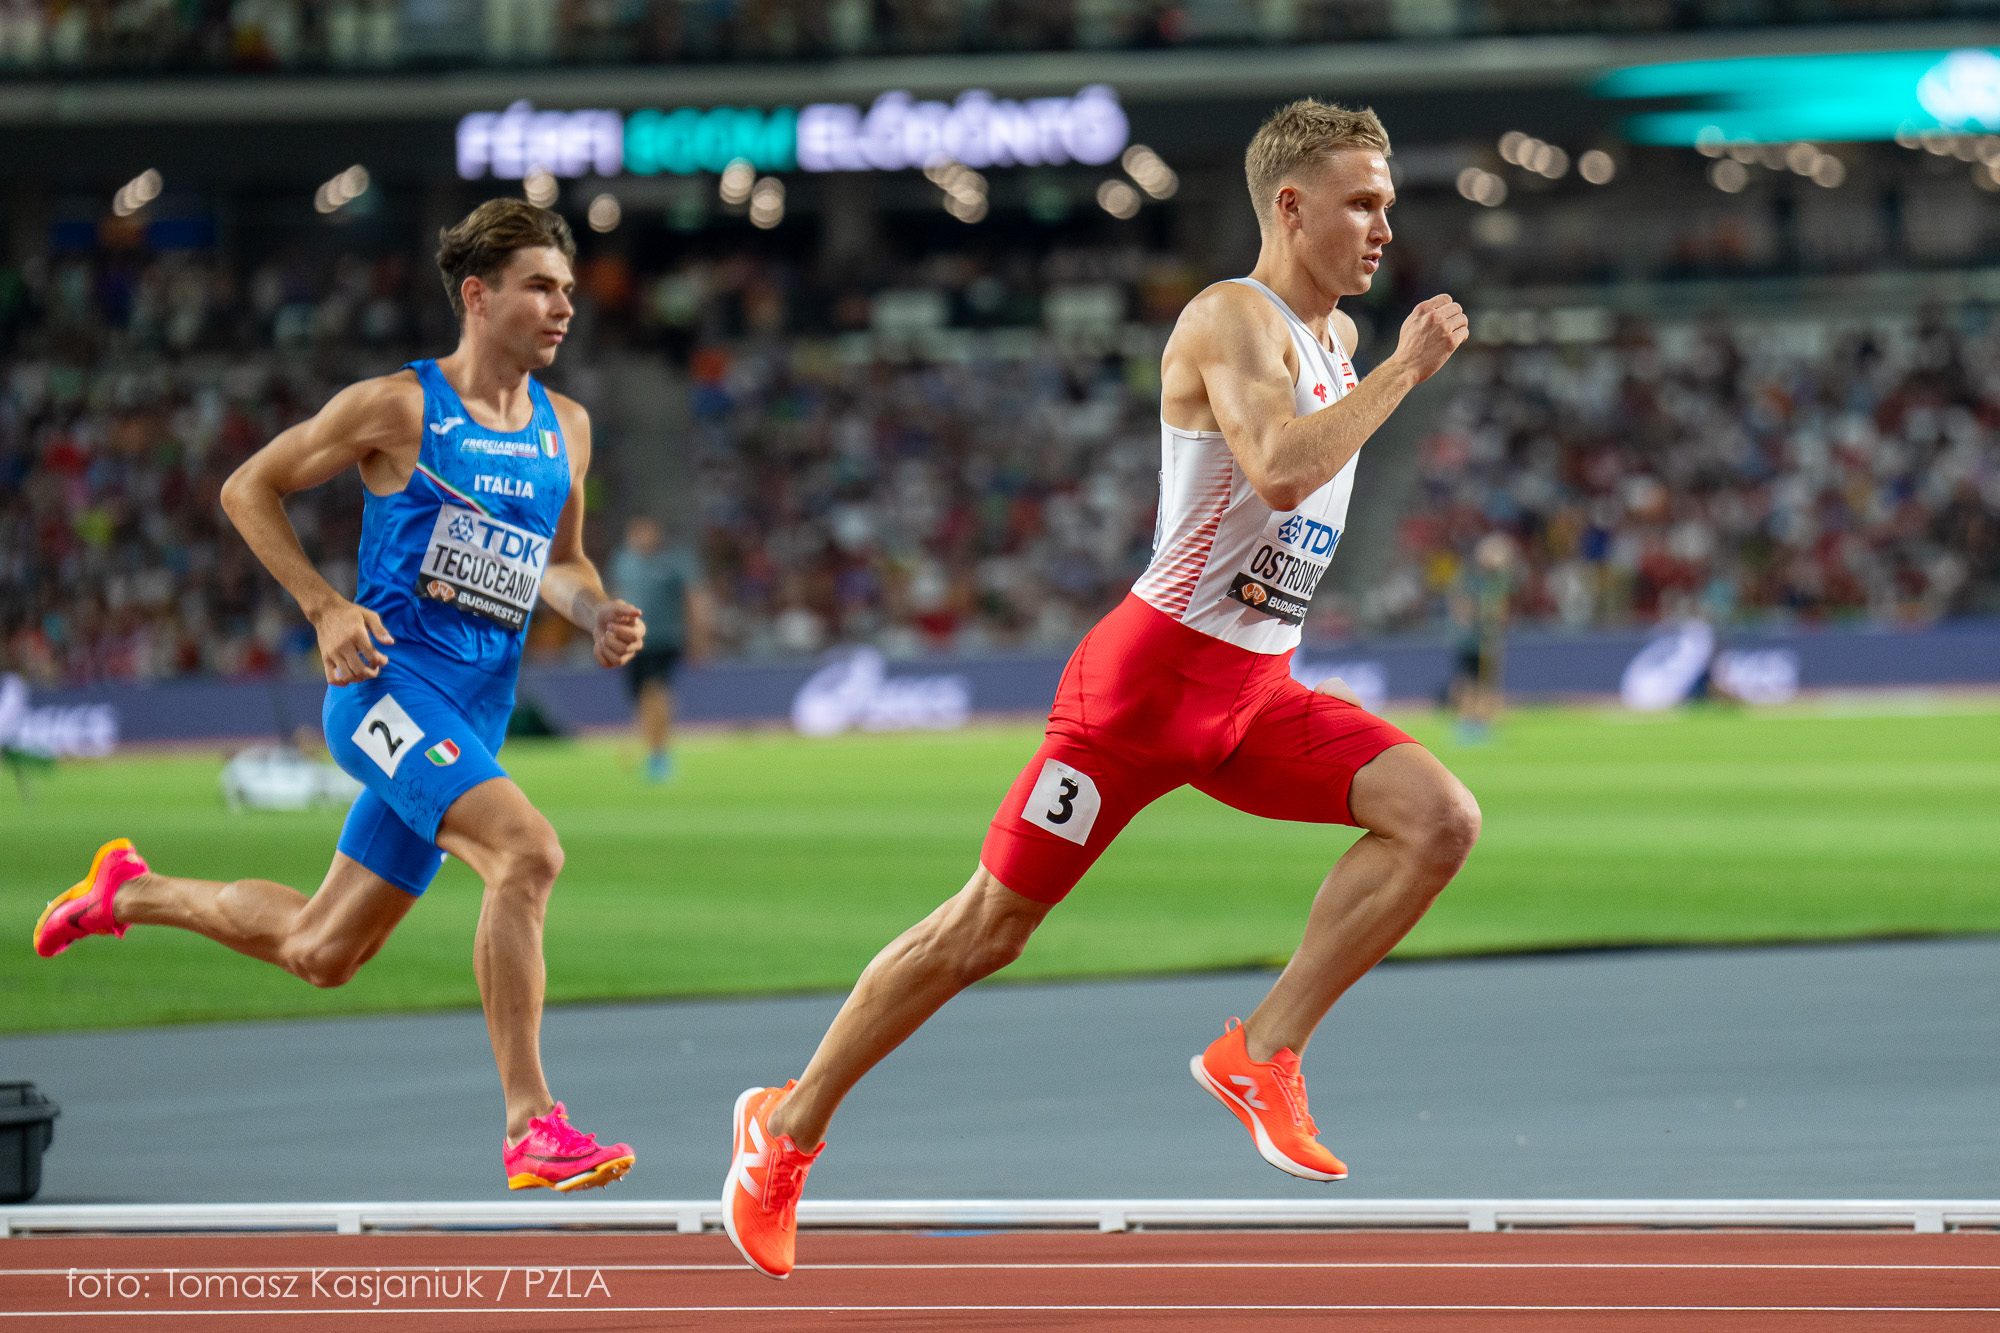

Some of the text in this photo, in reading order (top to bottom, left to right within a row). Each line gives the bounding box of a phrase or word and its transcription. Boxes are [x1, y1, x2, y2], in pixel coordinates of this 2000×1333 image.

[462, 438, 537, 454] FRECCIAROSSA
[474, 474, 534, 499] ITALIA
[478, 520, 543, 568] TDK
[432, 543, 536, 604] TECUCEANU
[368, 719, 404, 758] 2
[1046, 777, 1079, 825] 3
